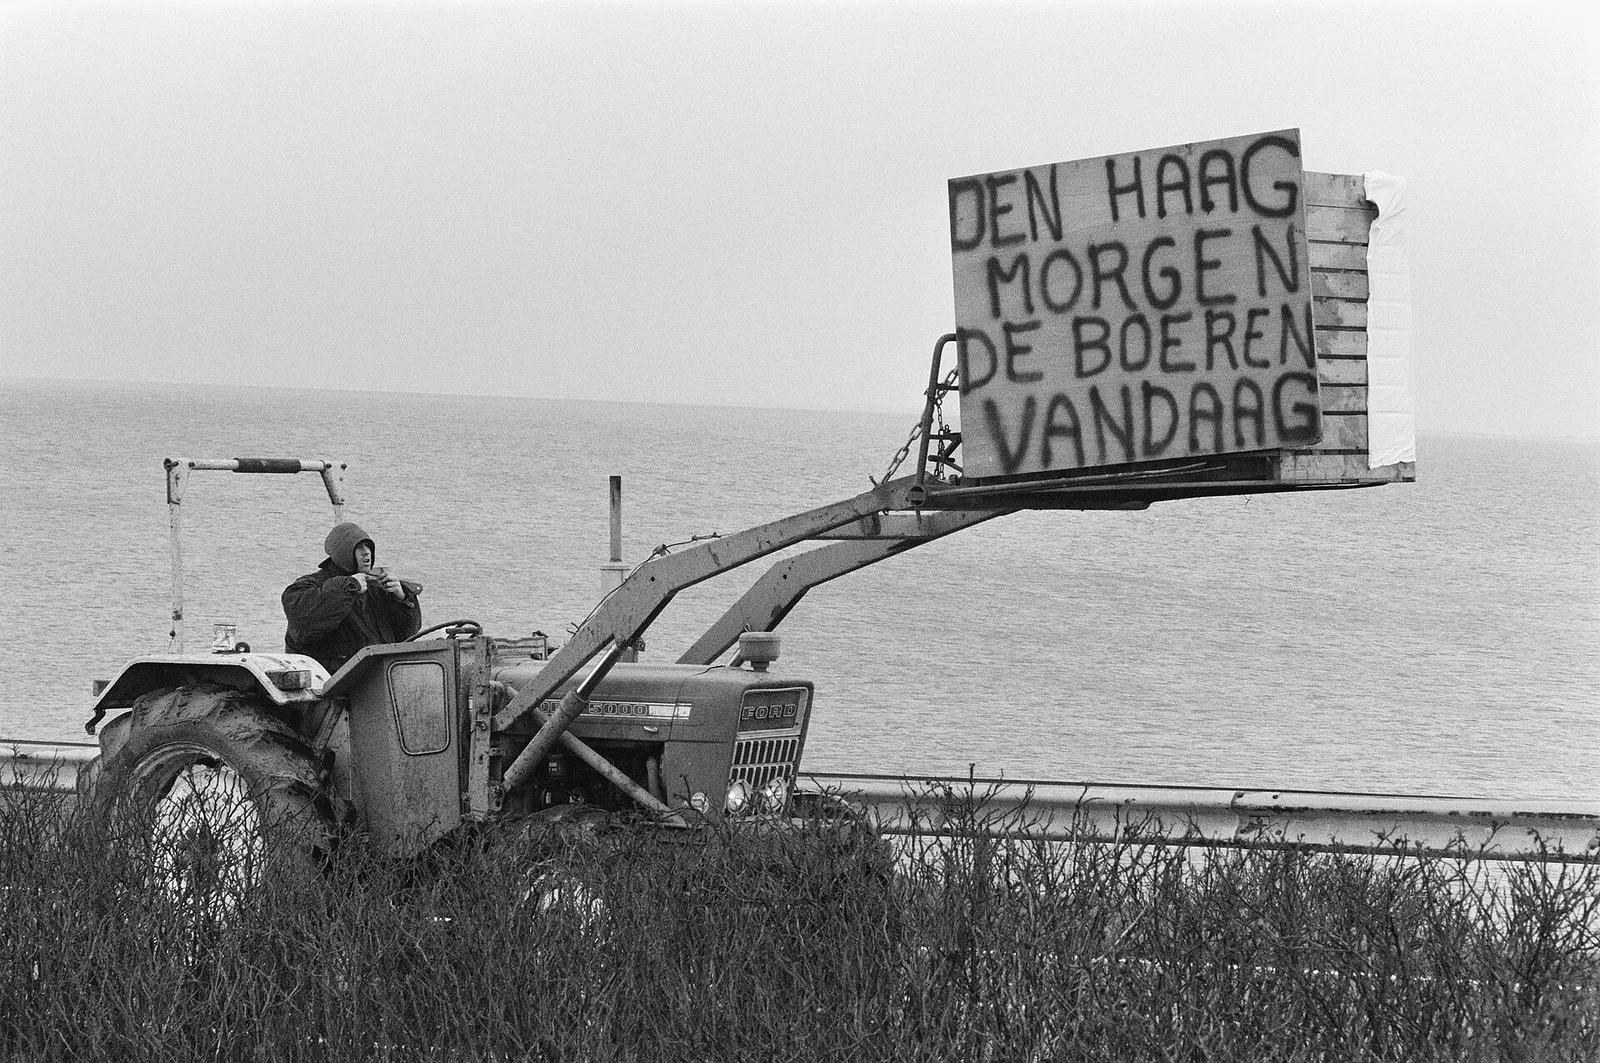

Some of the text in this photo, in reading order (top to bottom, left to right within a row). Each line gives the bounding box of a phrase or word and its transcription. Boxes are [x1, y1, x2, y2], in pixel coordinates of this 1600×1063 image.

[949, 136, 1300, 251] DEN HAAG
[986, 224, 1300, 318] MORGEN
[958, 302, 1316, 396] DE BOEREN
[985, 371, 1322, 473] VANDAAG
[588, 702, 648, 715] 5000
[741, 703, 797, 720] FORD
